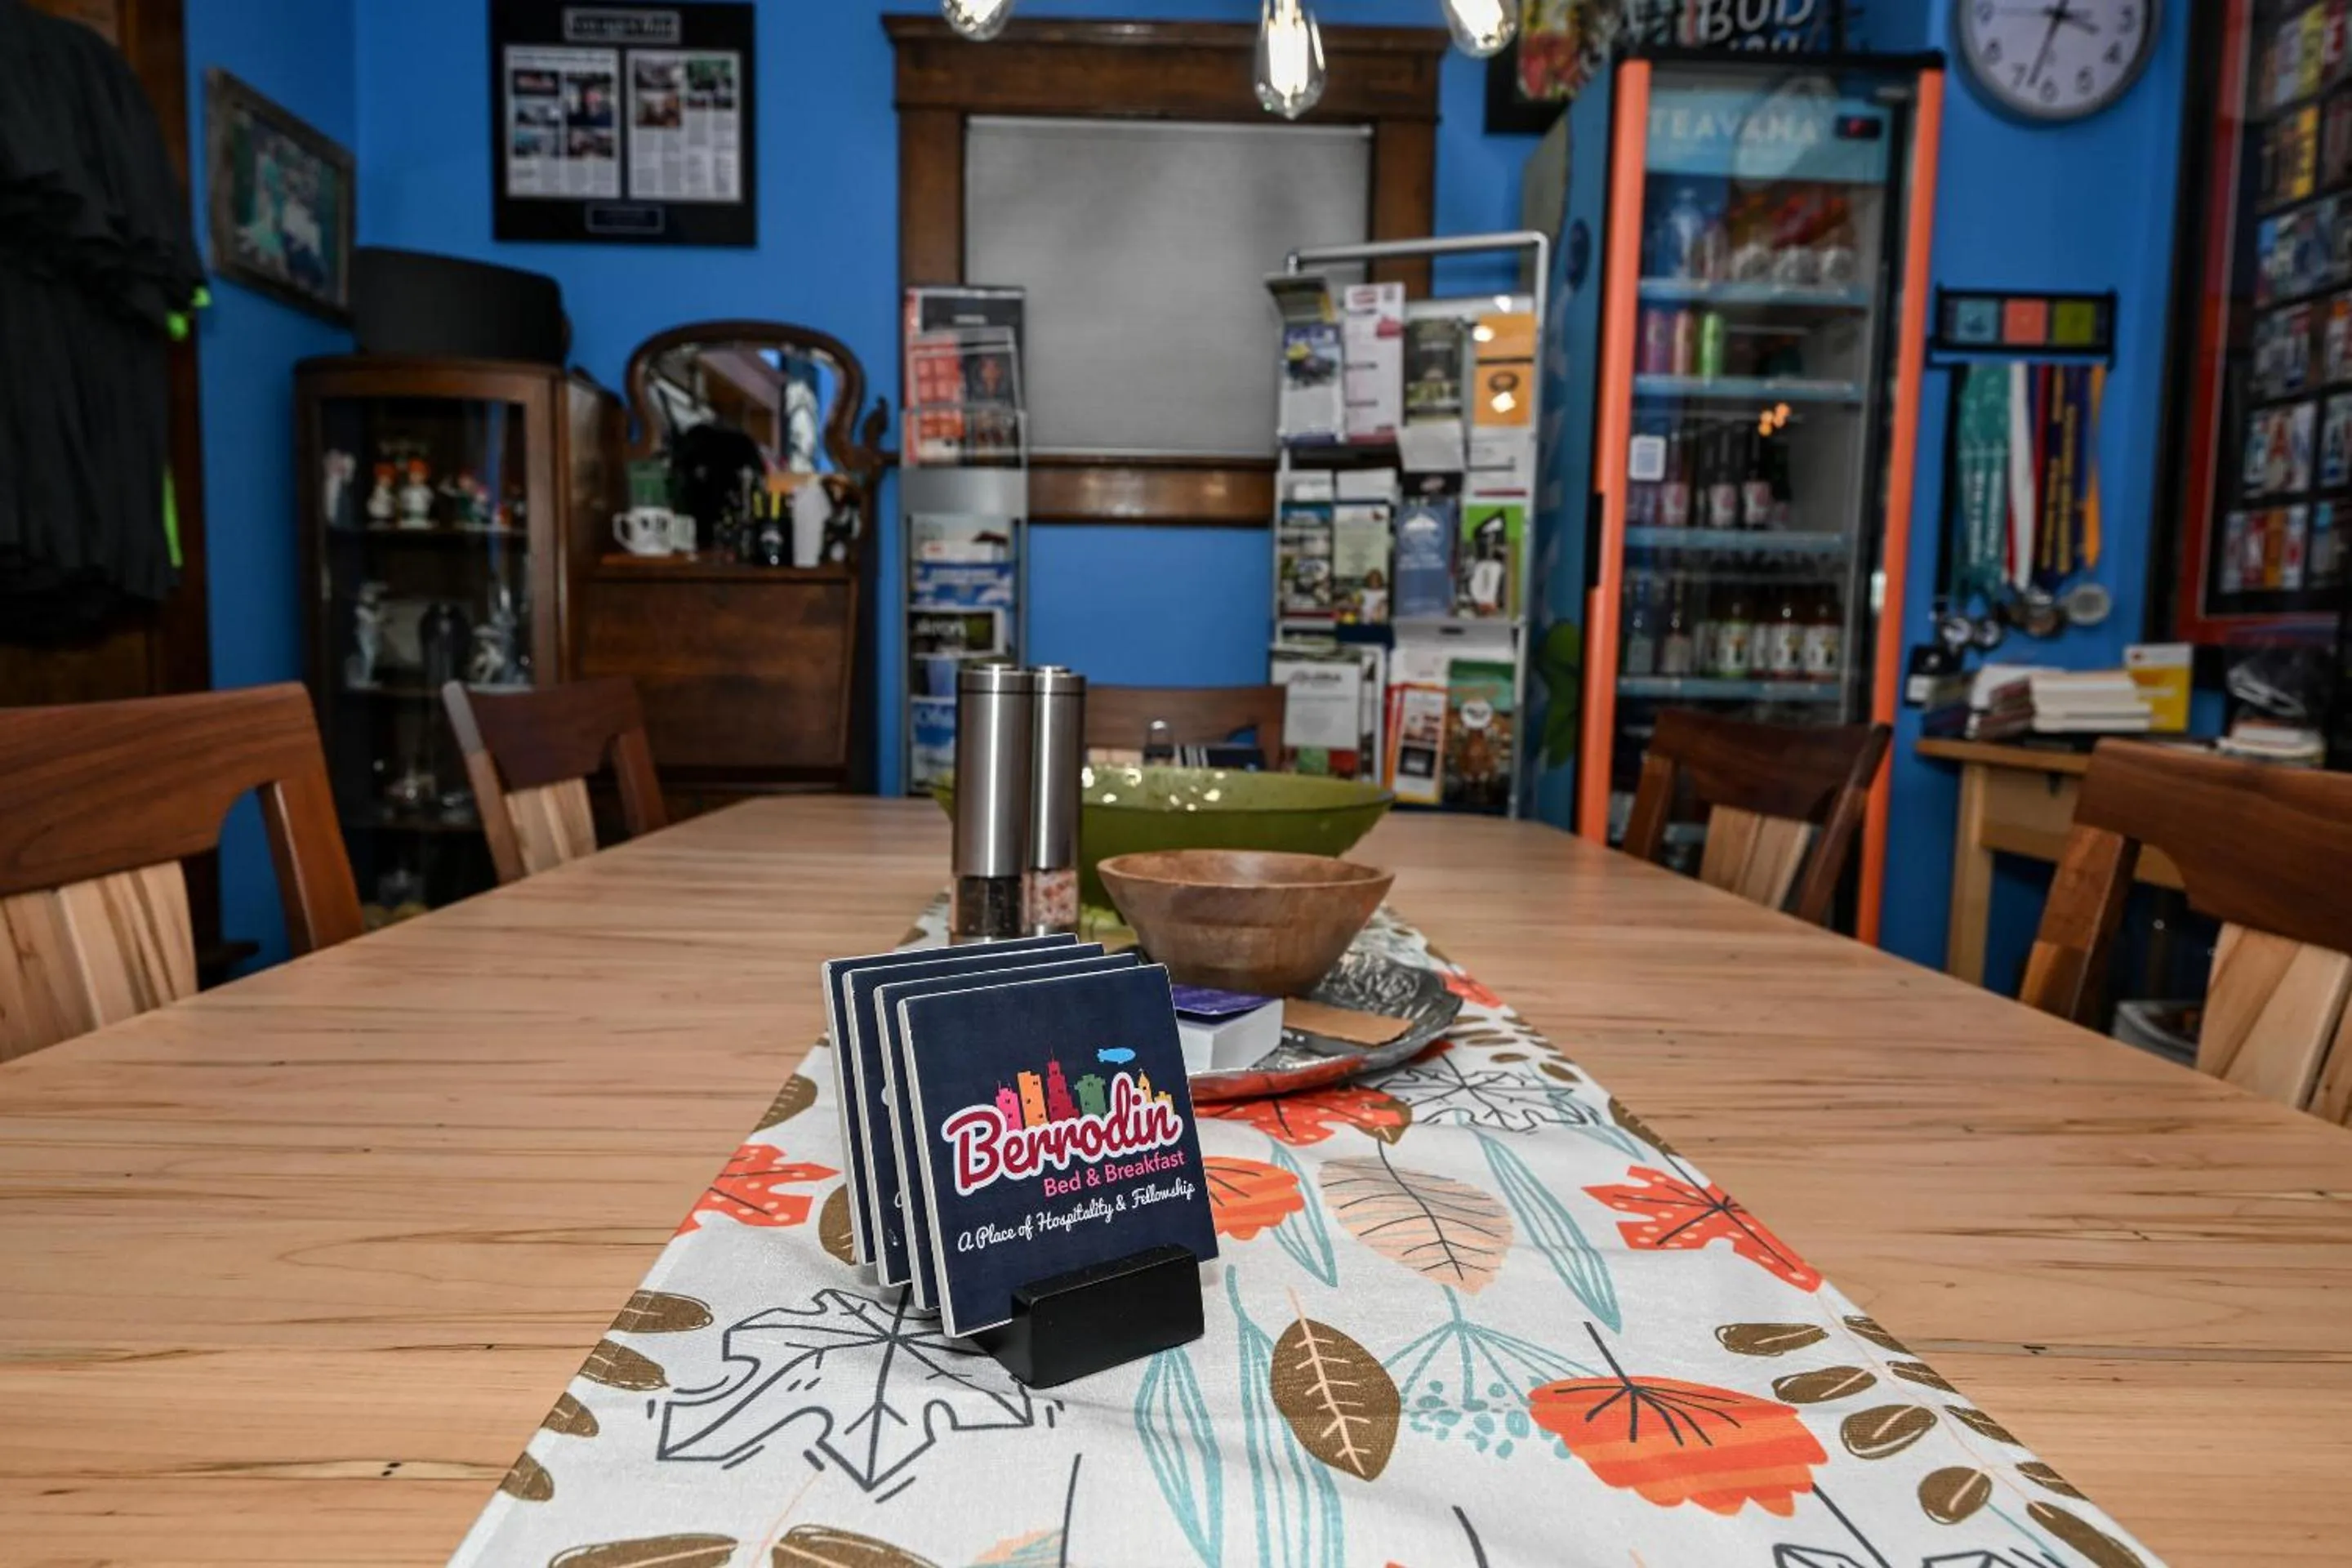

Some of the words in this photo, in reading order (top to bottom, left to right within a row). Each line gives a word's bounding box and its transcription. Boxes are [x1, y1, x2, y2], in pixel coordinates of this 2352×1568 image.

[942, 1072, 1183, 1196] Berrodin
[1043, 1170, 1082, 1197] Bed
[1087, 1167, 1101, 1187] &
[1105, 1149, 1186, 1184] Breakfast
[957, 1232, 975, 1252] A
[976, 1223, 1017, 1250] Place
[1018, 1218, 1034, 1241] of
[1037, 1197, 1114, 1233] Hospitality
[1116, 1195, 1127, 1212] &
[1131, 1178, 1196, 1209] Fellowship
